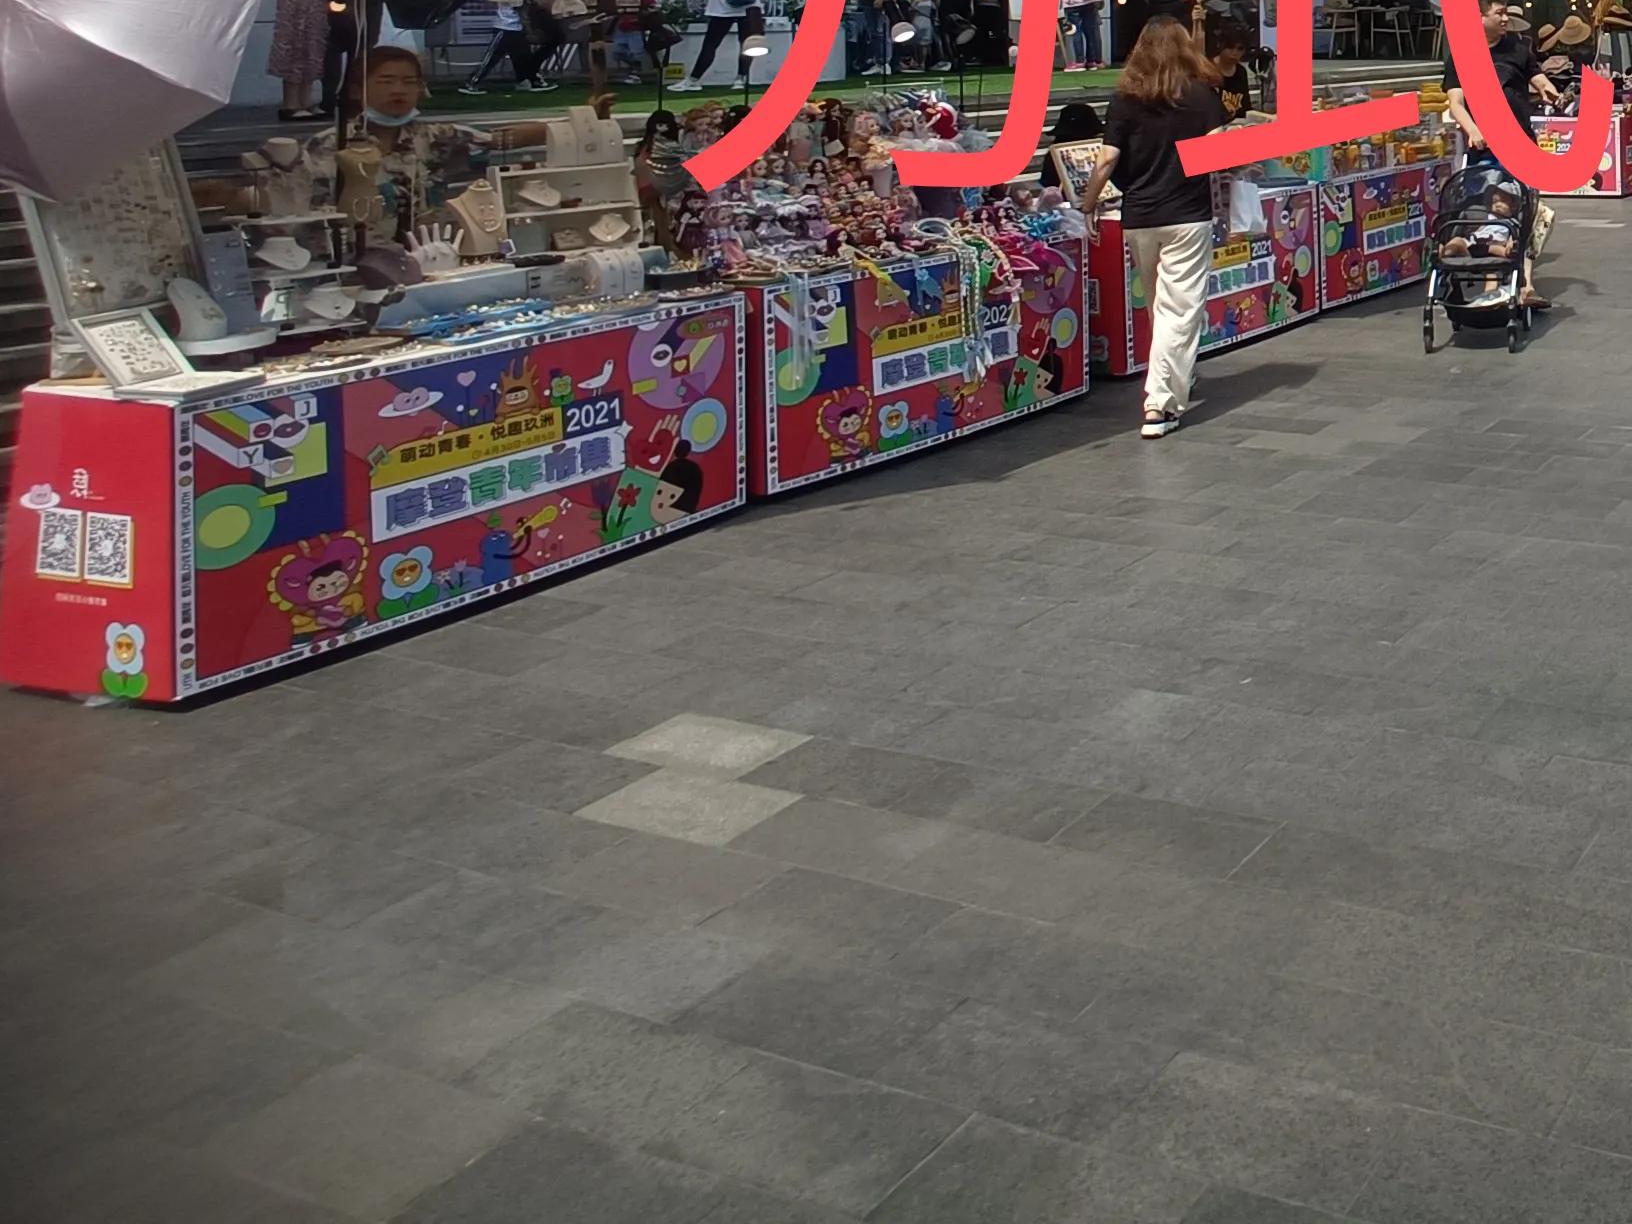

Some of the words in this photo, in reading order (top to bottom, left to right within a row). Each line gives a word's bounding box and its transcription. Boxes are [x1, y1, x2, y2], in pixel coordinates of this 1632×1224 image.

[1251, 240, 1273, 258] 2021
[984, 303, 1013, 326] 202
[566, 397, 621, 433] 2021
